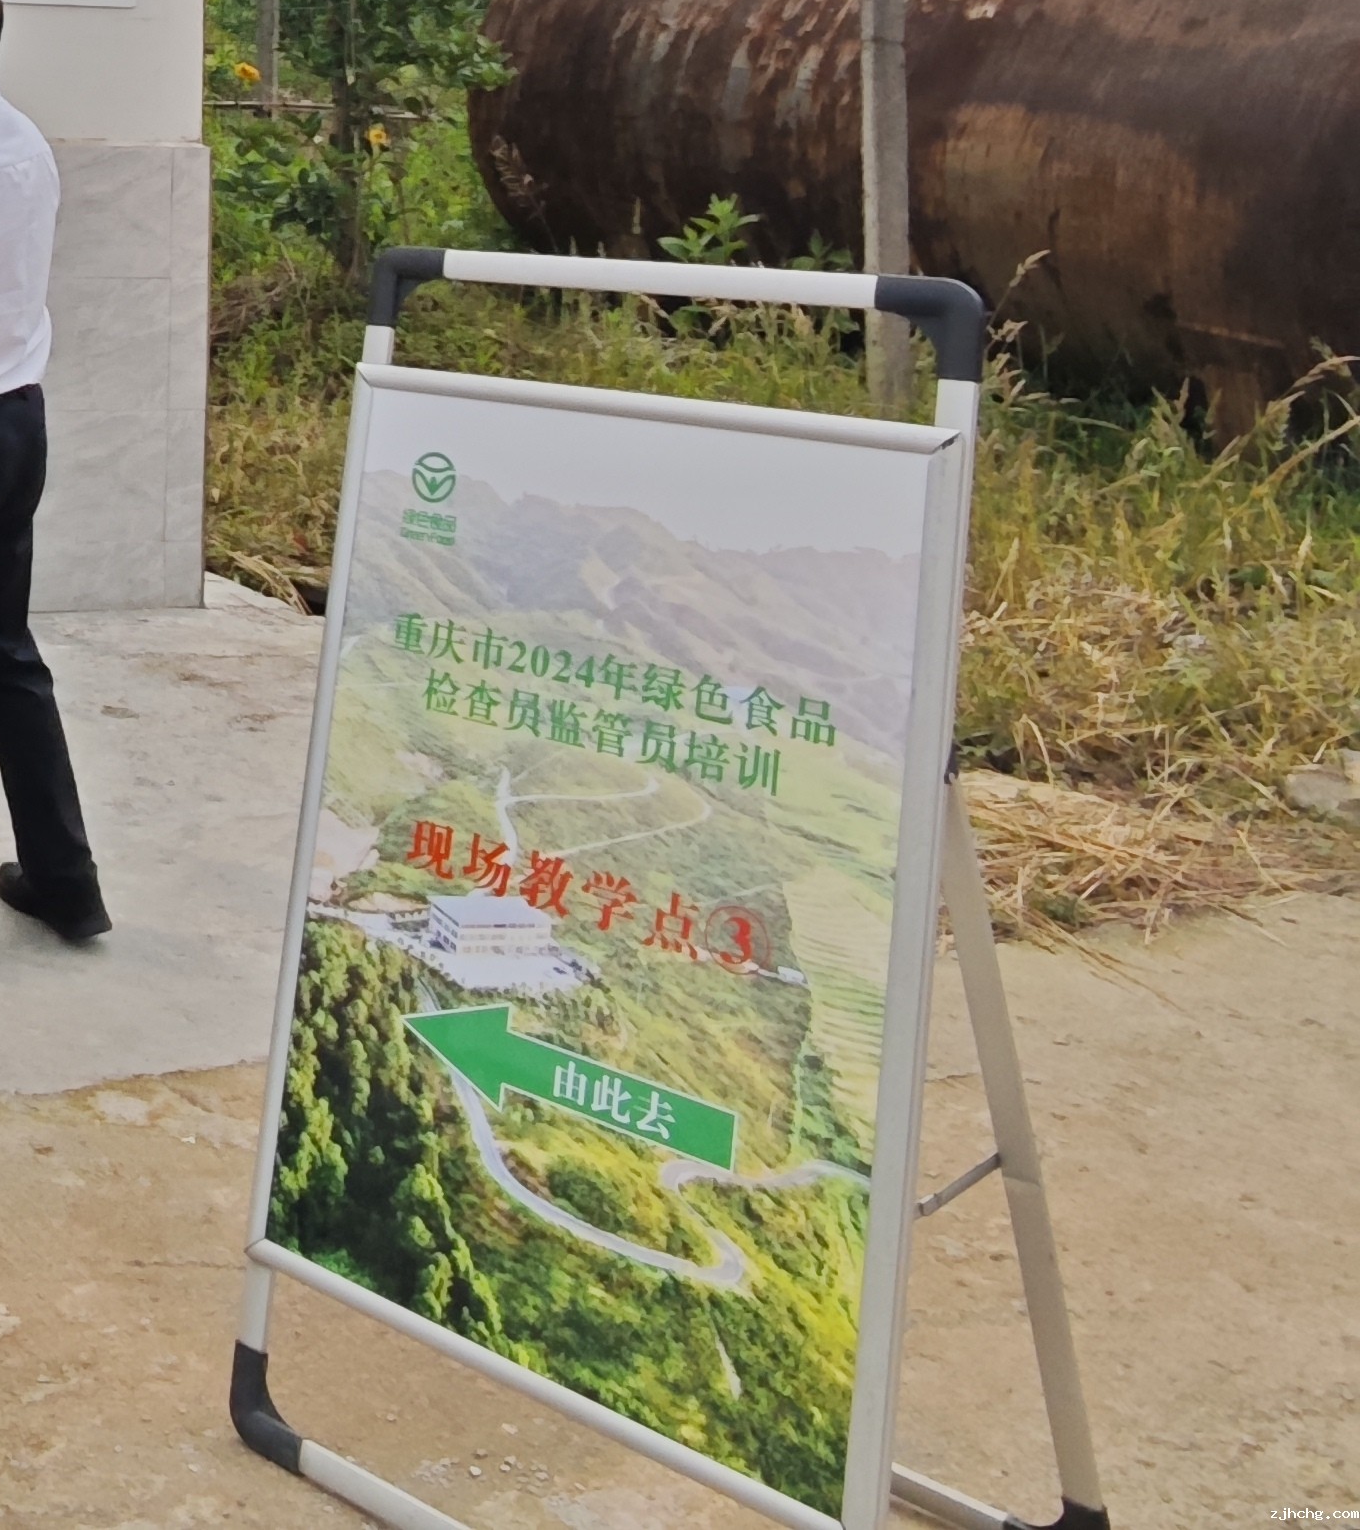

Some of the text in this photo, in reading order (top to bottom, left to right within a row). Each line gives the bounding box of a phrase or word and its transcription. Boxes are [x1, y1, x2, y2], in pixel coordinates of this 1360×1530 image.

[392, 612, 837, 747] 重庆市2024年绿色食品
[421, 667, 782, 797] 检查员监管员培训
[552, 1061, 676, 1140] 由此去
